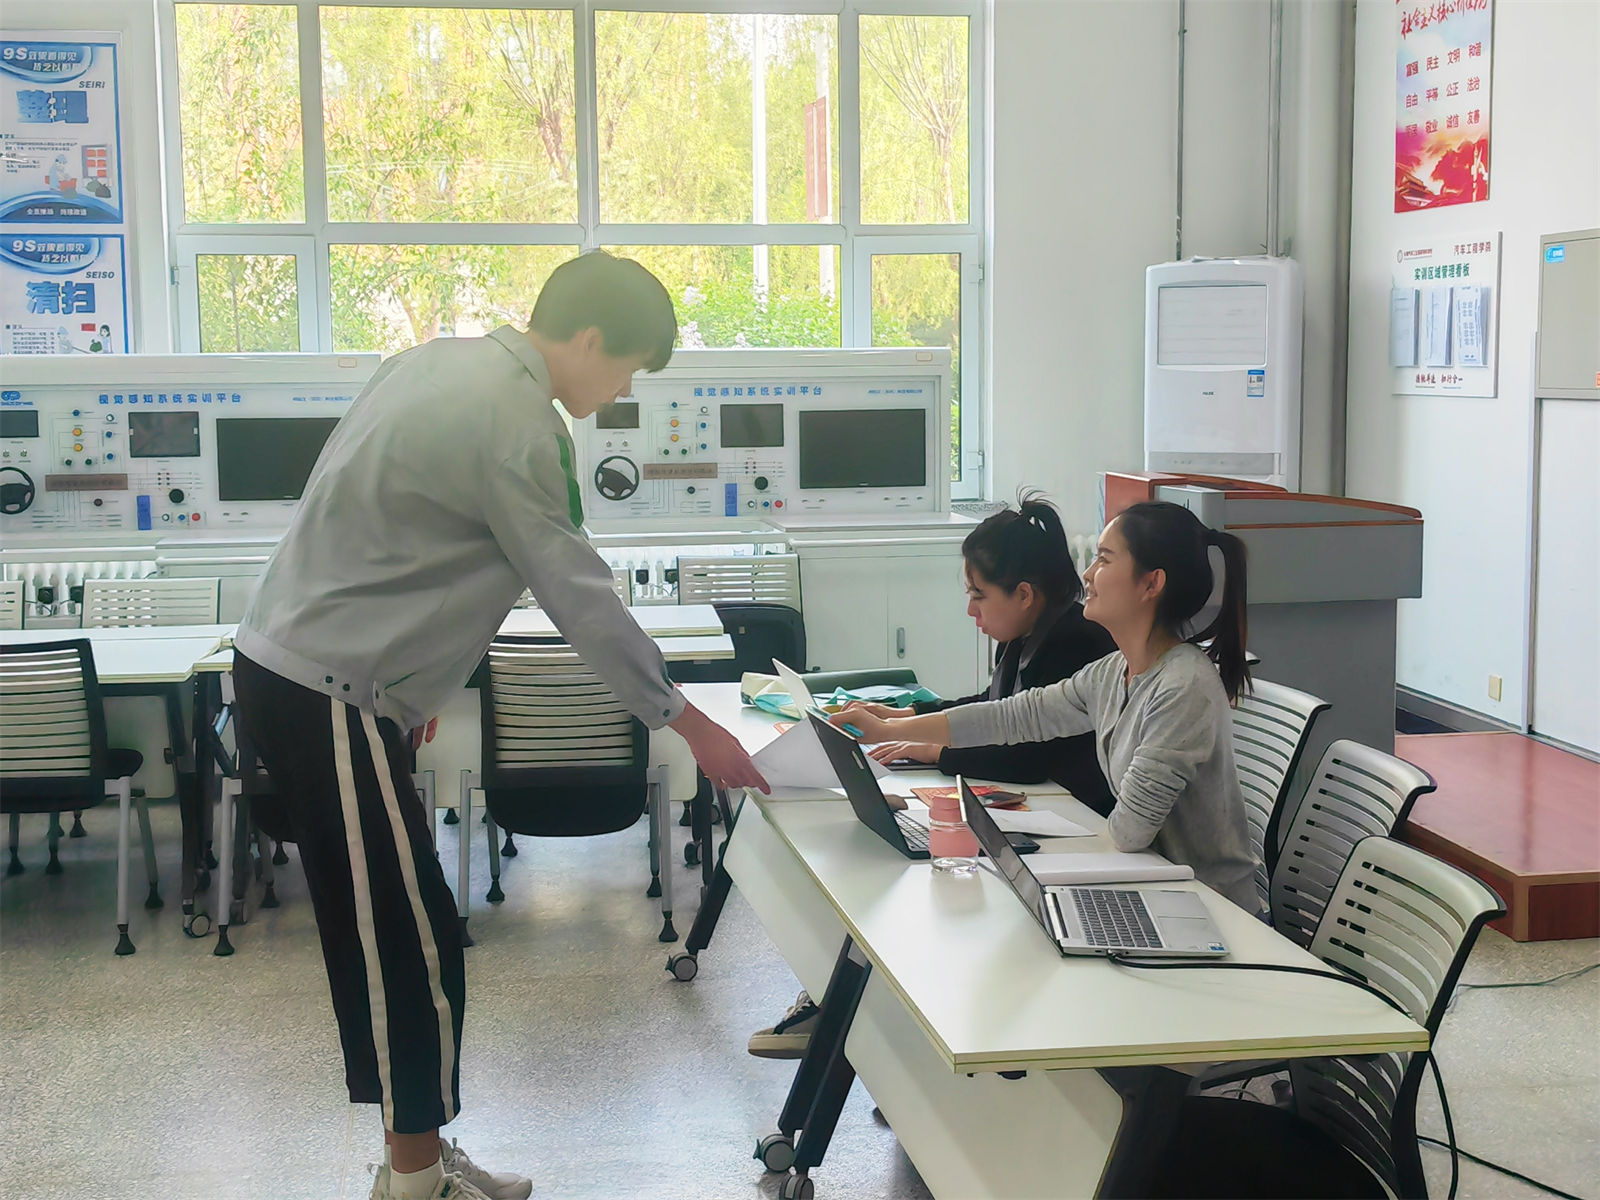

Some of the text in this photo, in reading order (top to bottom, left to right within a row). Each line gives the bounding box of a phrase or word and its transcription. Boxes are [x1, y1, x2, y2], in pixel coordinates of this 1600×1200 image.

[1406, 43, 1482, 78] 富强 民主 文明 和谐
[79, 81, 106, 89] SEIRI
[1406, 77, 1480, 108] 自由 平等 公正 法治
[1425, 120, 1438, 134] 敬业
[1446, 114, 1459, 129] 诚信
[1467, 110, 1480, 125] 友善
[1454, 241, 1492, 256] 汽车工程学院
[85, 271, 115, 279] SEISO
[1414, 263, 1470, 281] 实训区域管理看板
[26, 280, 96, 315] 清扫
[99, 392, 242, 405] 视觉感知系统实训平台
[694, 385, 822, 397] 视觉感知系统实训平台
